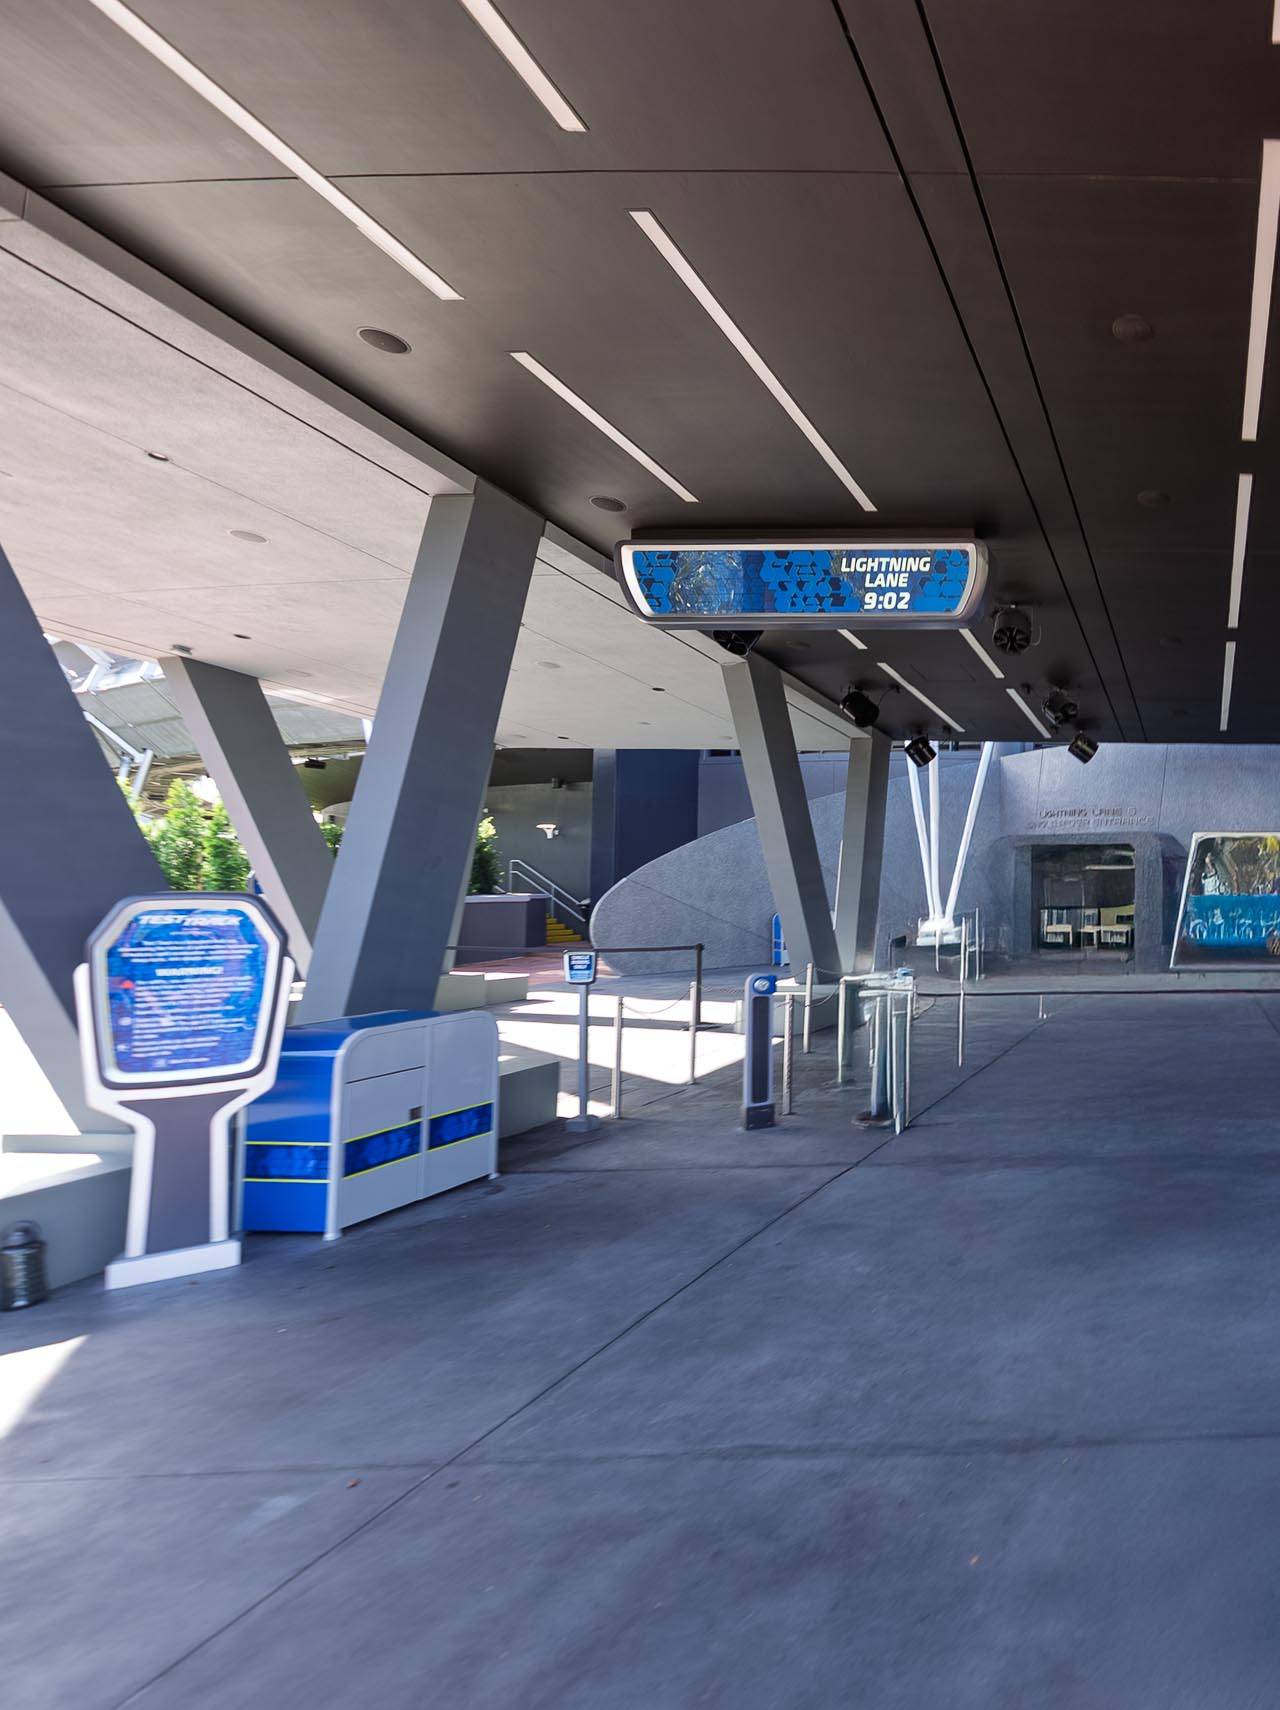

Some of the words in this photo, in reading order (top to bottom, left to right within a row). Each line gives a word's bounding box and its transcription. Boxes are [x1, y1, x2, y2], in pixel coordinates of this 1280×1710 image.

[840, 556, 931, 573] LIGHTNING
[864, 573, 909, 588] LANE
[863, 591, 911, 610] 9:02
[138, 914, 189, 925] TEST
[182, 915, 244, 926] TRACK
